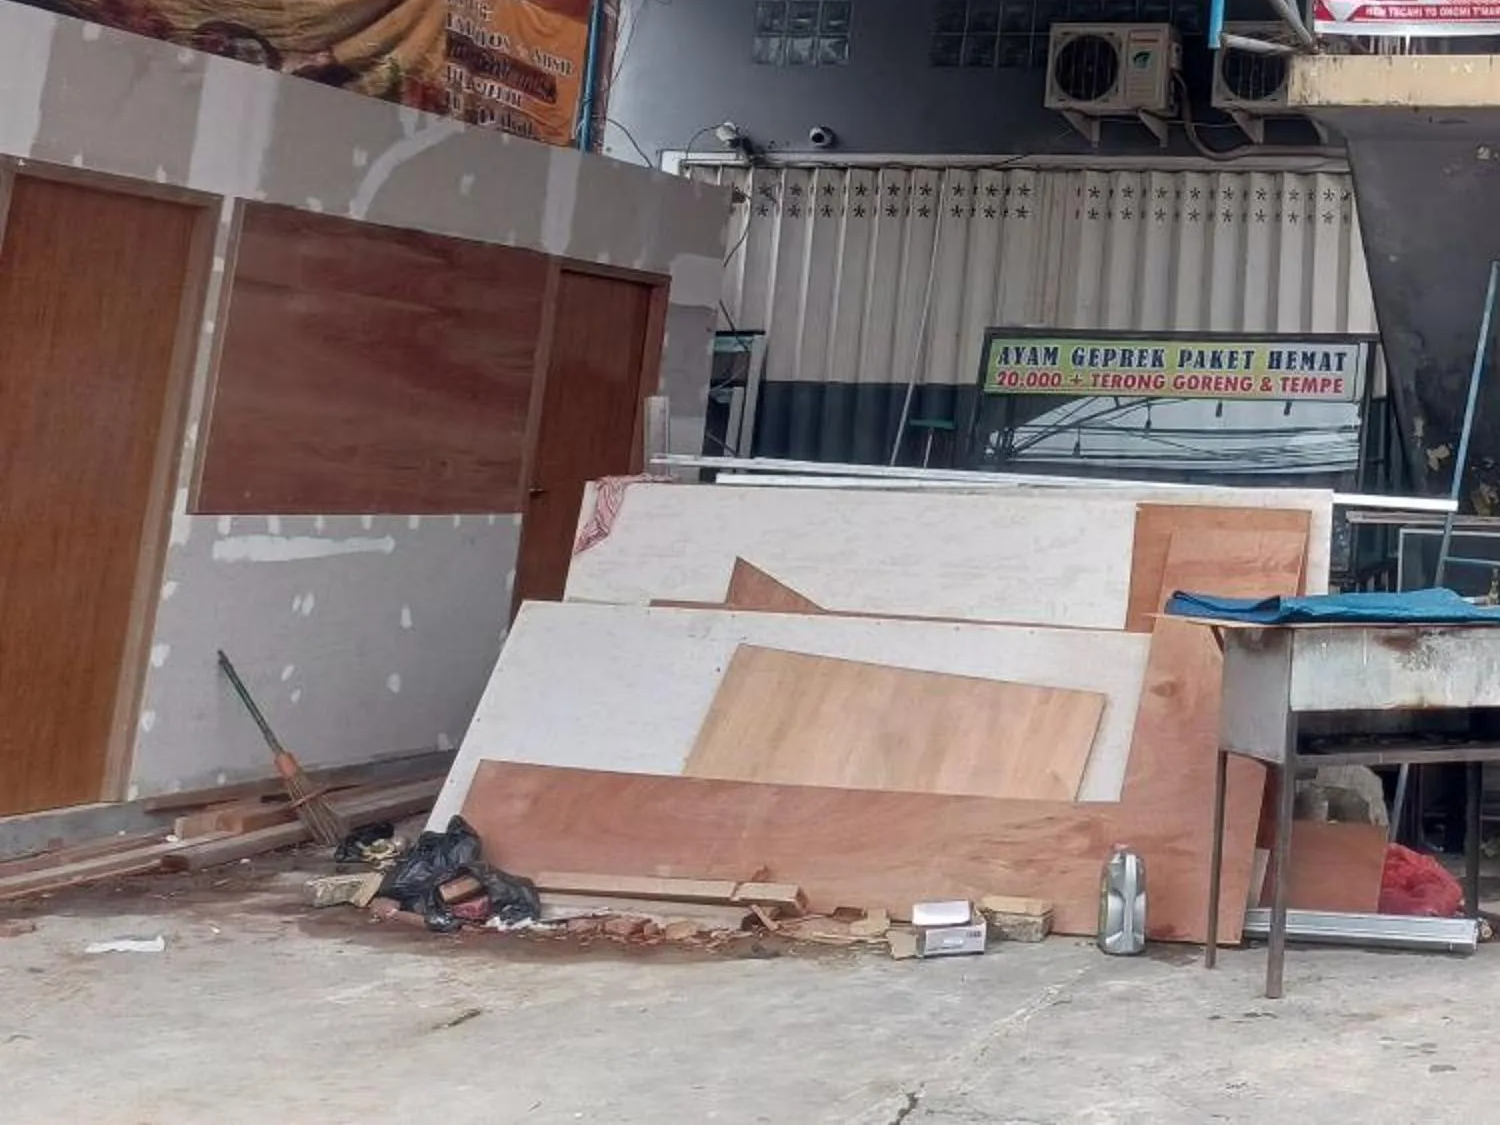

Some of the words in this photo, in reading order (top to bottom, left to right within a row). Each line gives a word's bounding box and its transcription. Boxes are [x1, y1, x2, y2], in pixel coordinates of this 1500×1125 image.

[998, 346, 1060, 366] AYAM
[1071, 347, 1165, 368] GEPREK
[1178, 349, 1255, 370] PAKET
[1267, 351, 1347, 372] HEMAT
[1091, 373, 1165, 389] TERONG
[1173, 375, 1253, 392] GORENG
[1259, 377, 1273, 392] &
[1280, 377, 1344, 394] TEMPE
